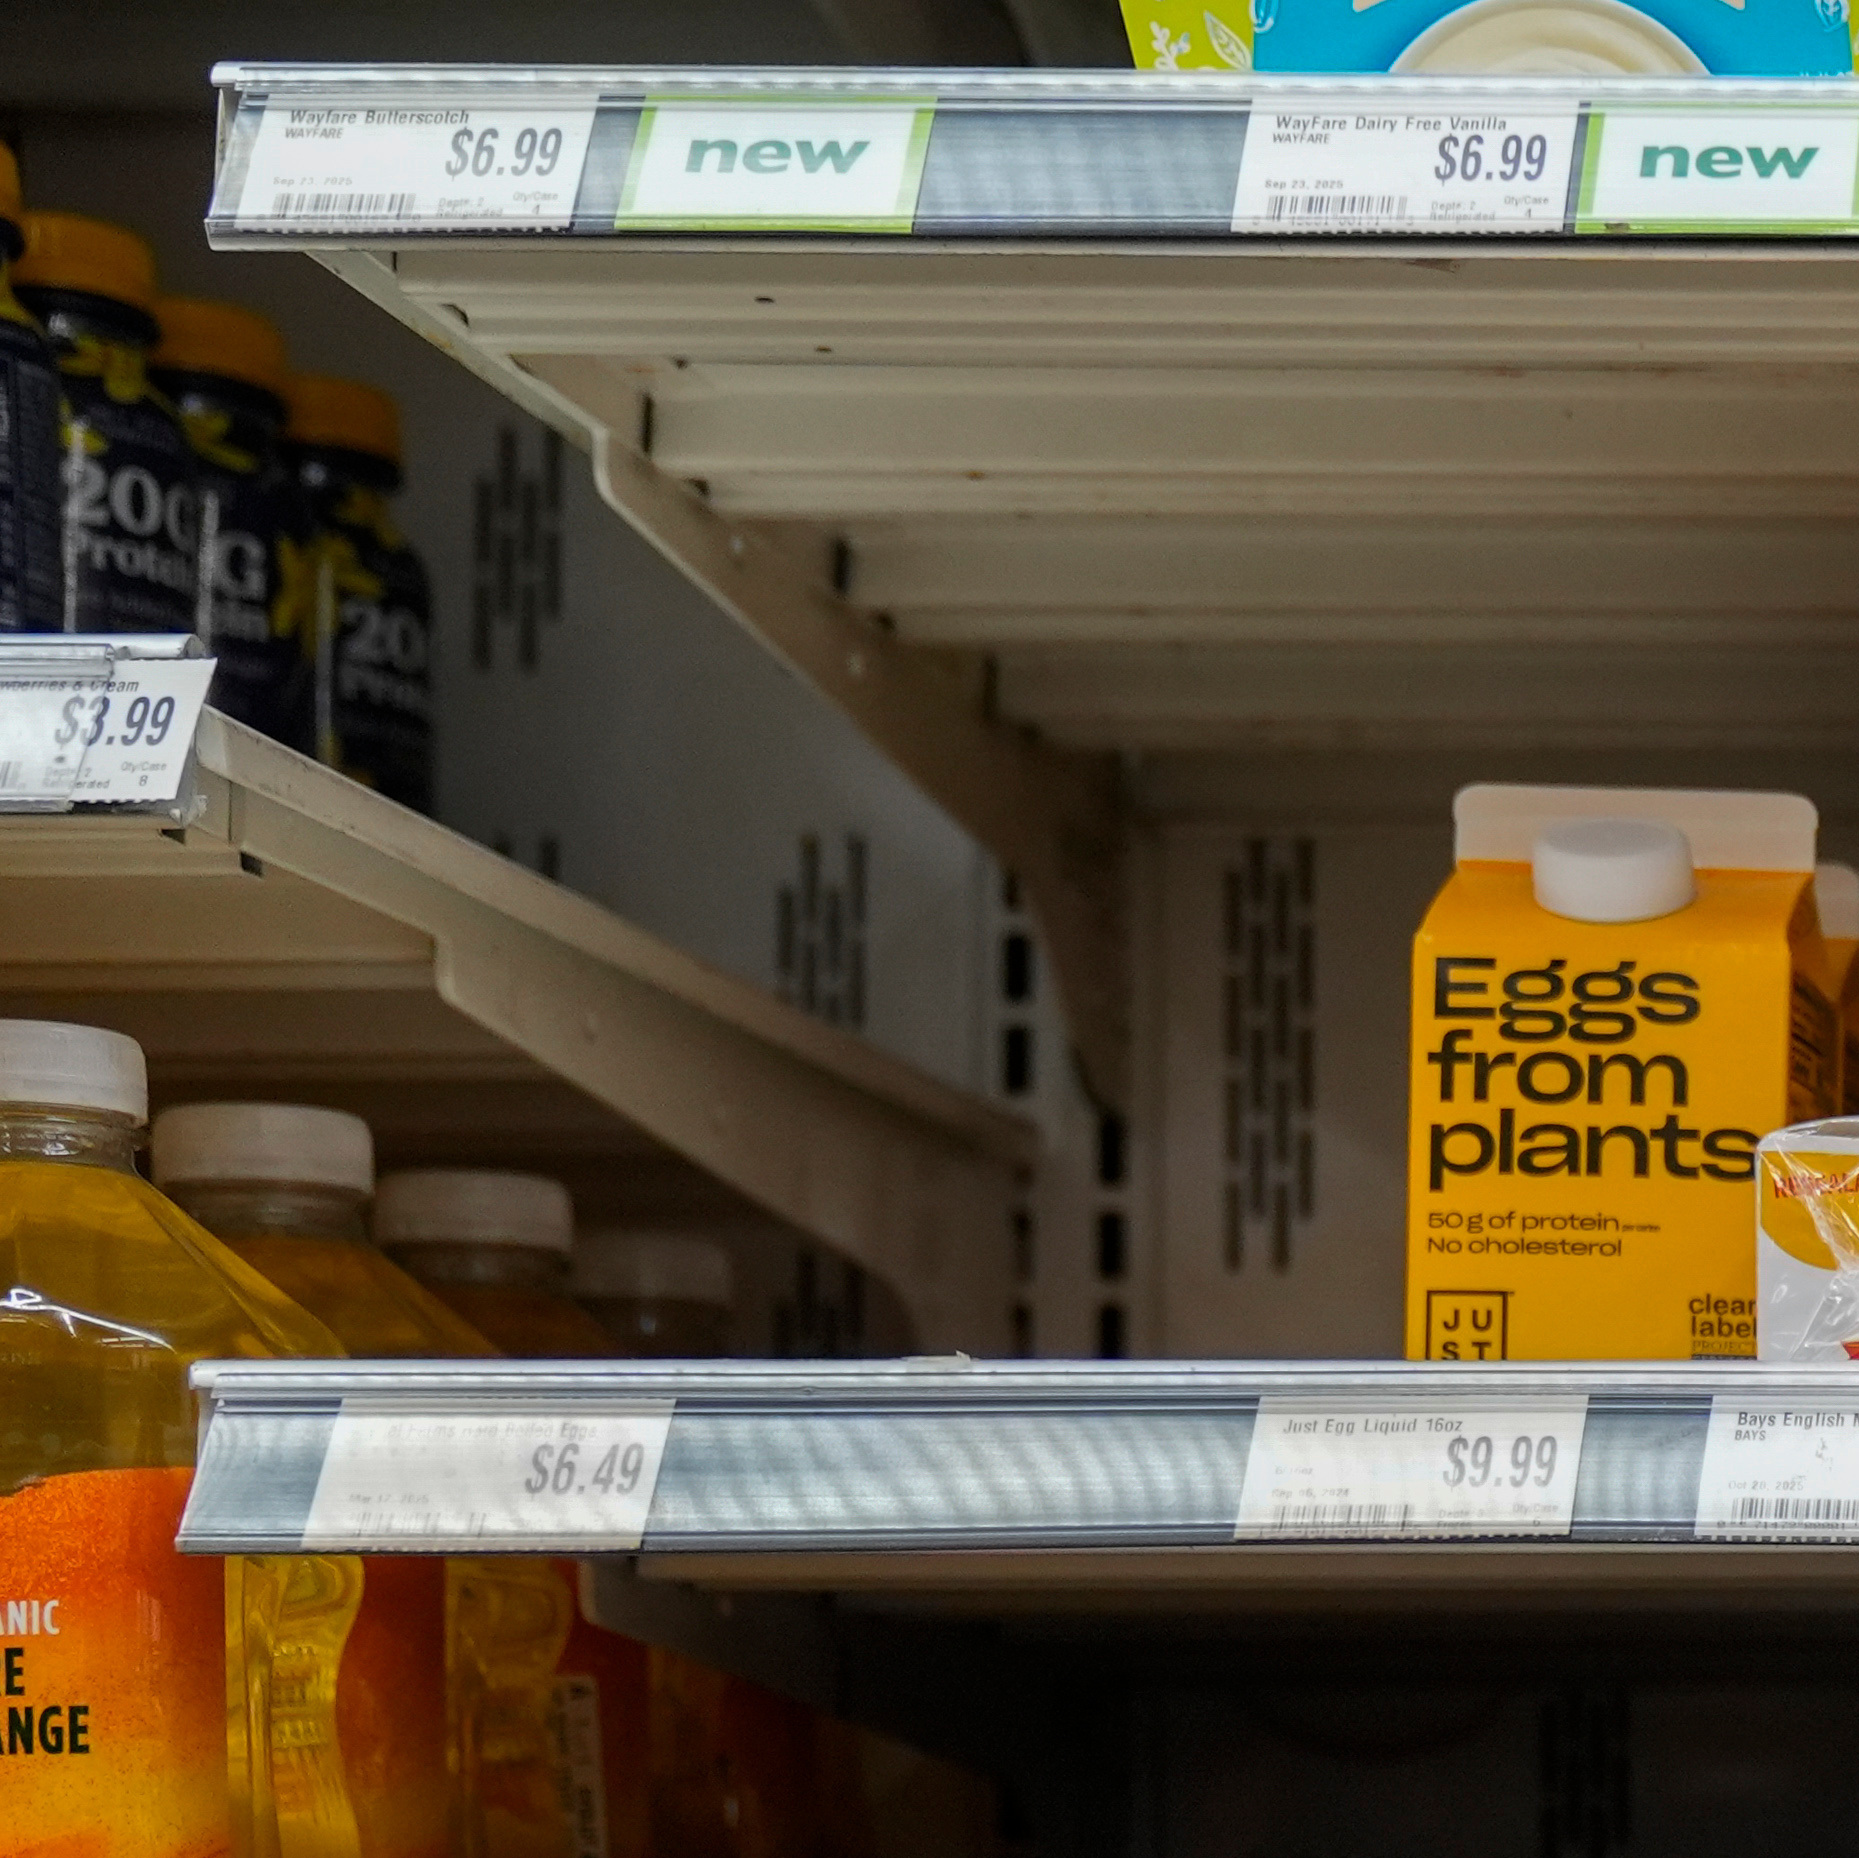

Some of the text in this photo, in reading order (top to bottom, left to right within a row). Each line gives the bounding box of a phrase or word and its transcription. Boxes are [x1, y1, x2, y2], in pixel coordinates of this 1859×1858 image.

[290, 109, 469, 125] Wayfare Butterscotch
[1276, 115, 1507, 133] WayFare Dairy Free Vanilla
[445, 127, 563, 180] $6.99
[686, 138, 870, 174] new
[1435, 133, 1547, 186] $6.99
[1639, 145, 1819, 179] new
[55, 695, 174, 757] $3.99
[1434, 957, 1701, 1044] Eggs
[1427, 1029, 1689, 1107] from
[1428, 1108, 1758, 1192] plants
[1427, 1211, 1620, 1233] 50 protein
[1427, 1237, 1623, 1257] No cholesterol
[1283, 1418, 1463, 1436] Just Egg Liquid 16oz
[1737, 1412, 1777, 1429] Bays
[1783, 1412, 1845, 1429] English
[525, 1443, 645, 1500] $6.49
[1443, 1435, 1558, 1491] $9.99
